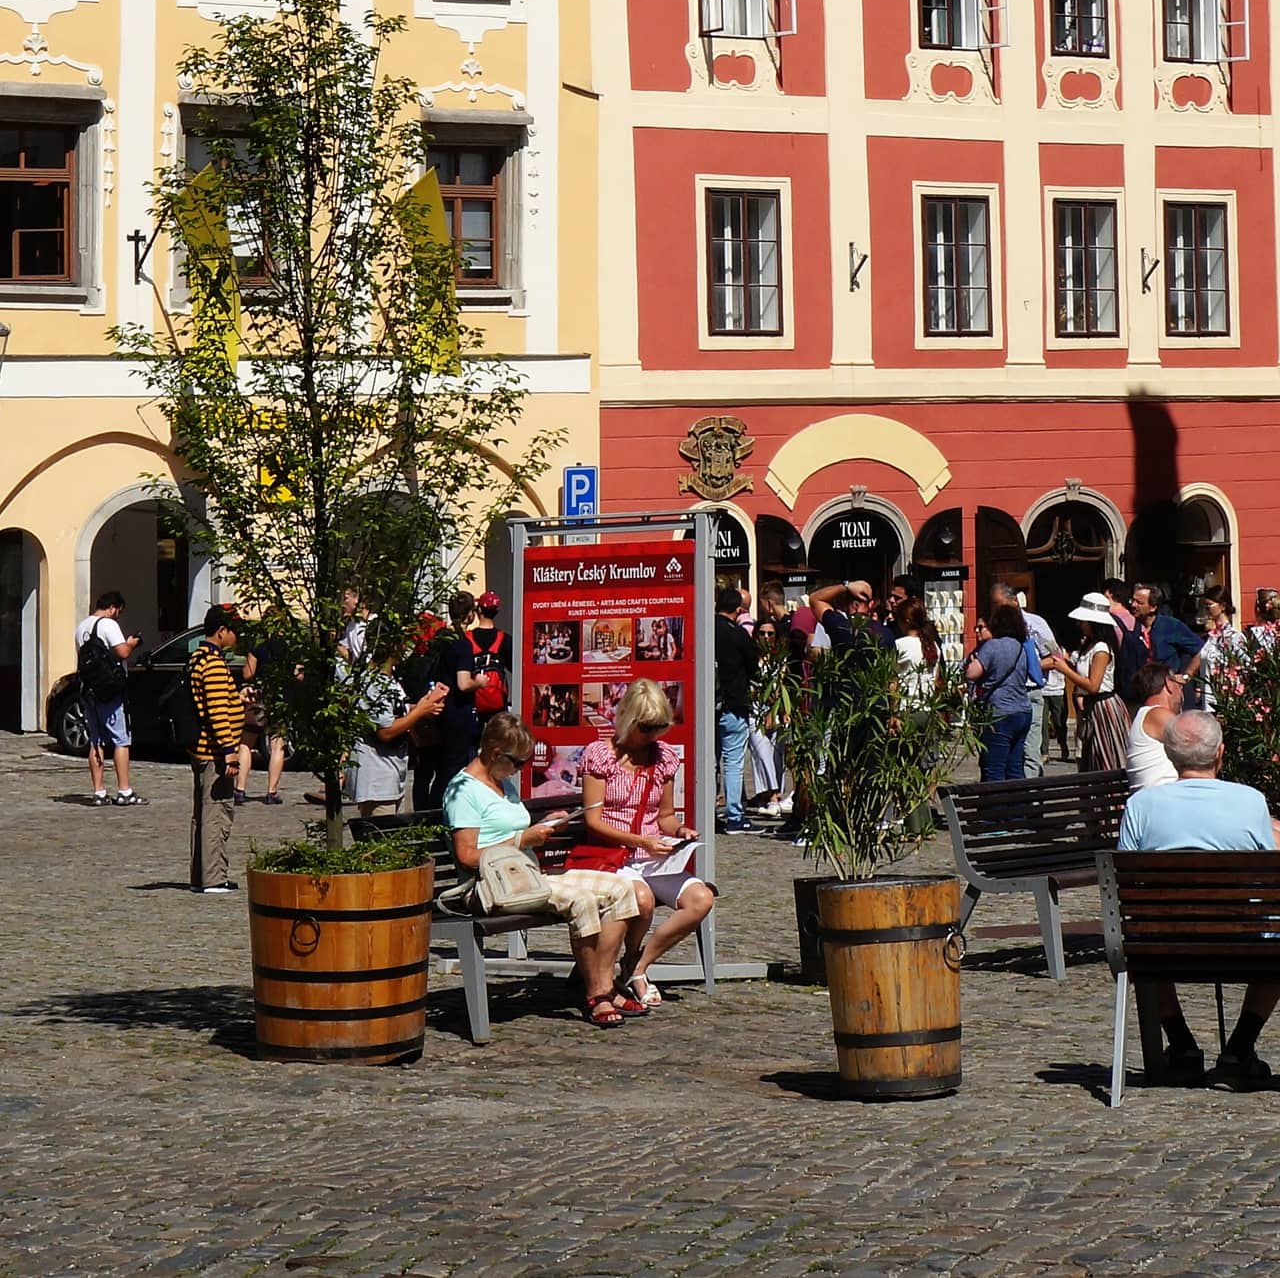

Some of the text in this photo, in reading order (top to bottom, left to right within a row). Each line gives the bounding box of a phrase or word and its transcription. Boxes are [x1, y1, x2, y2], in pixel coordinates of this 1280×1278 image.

[571, 474, 591, 508] P
[839, 521, 870, 538] TONI
[717, 530, 732, 547] NI
[832, 538, 878, 549] JEWELLERY
[532, 562, 657, 586] Kláštery Český Krumlov
